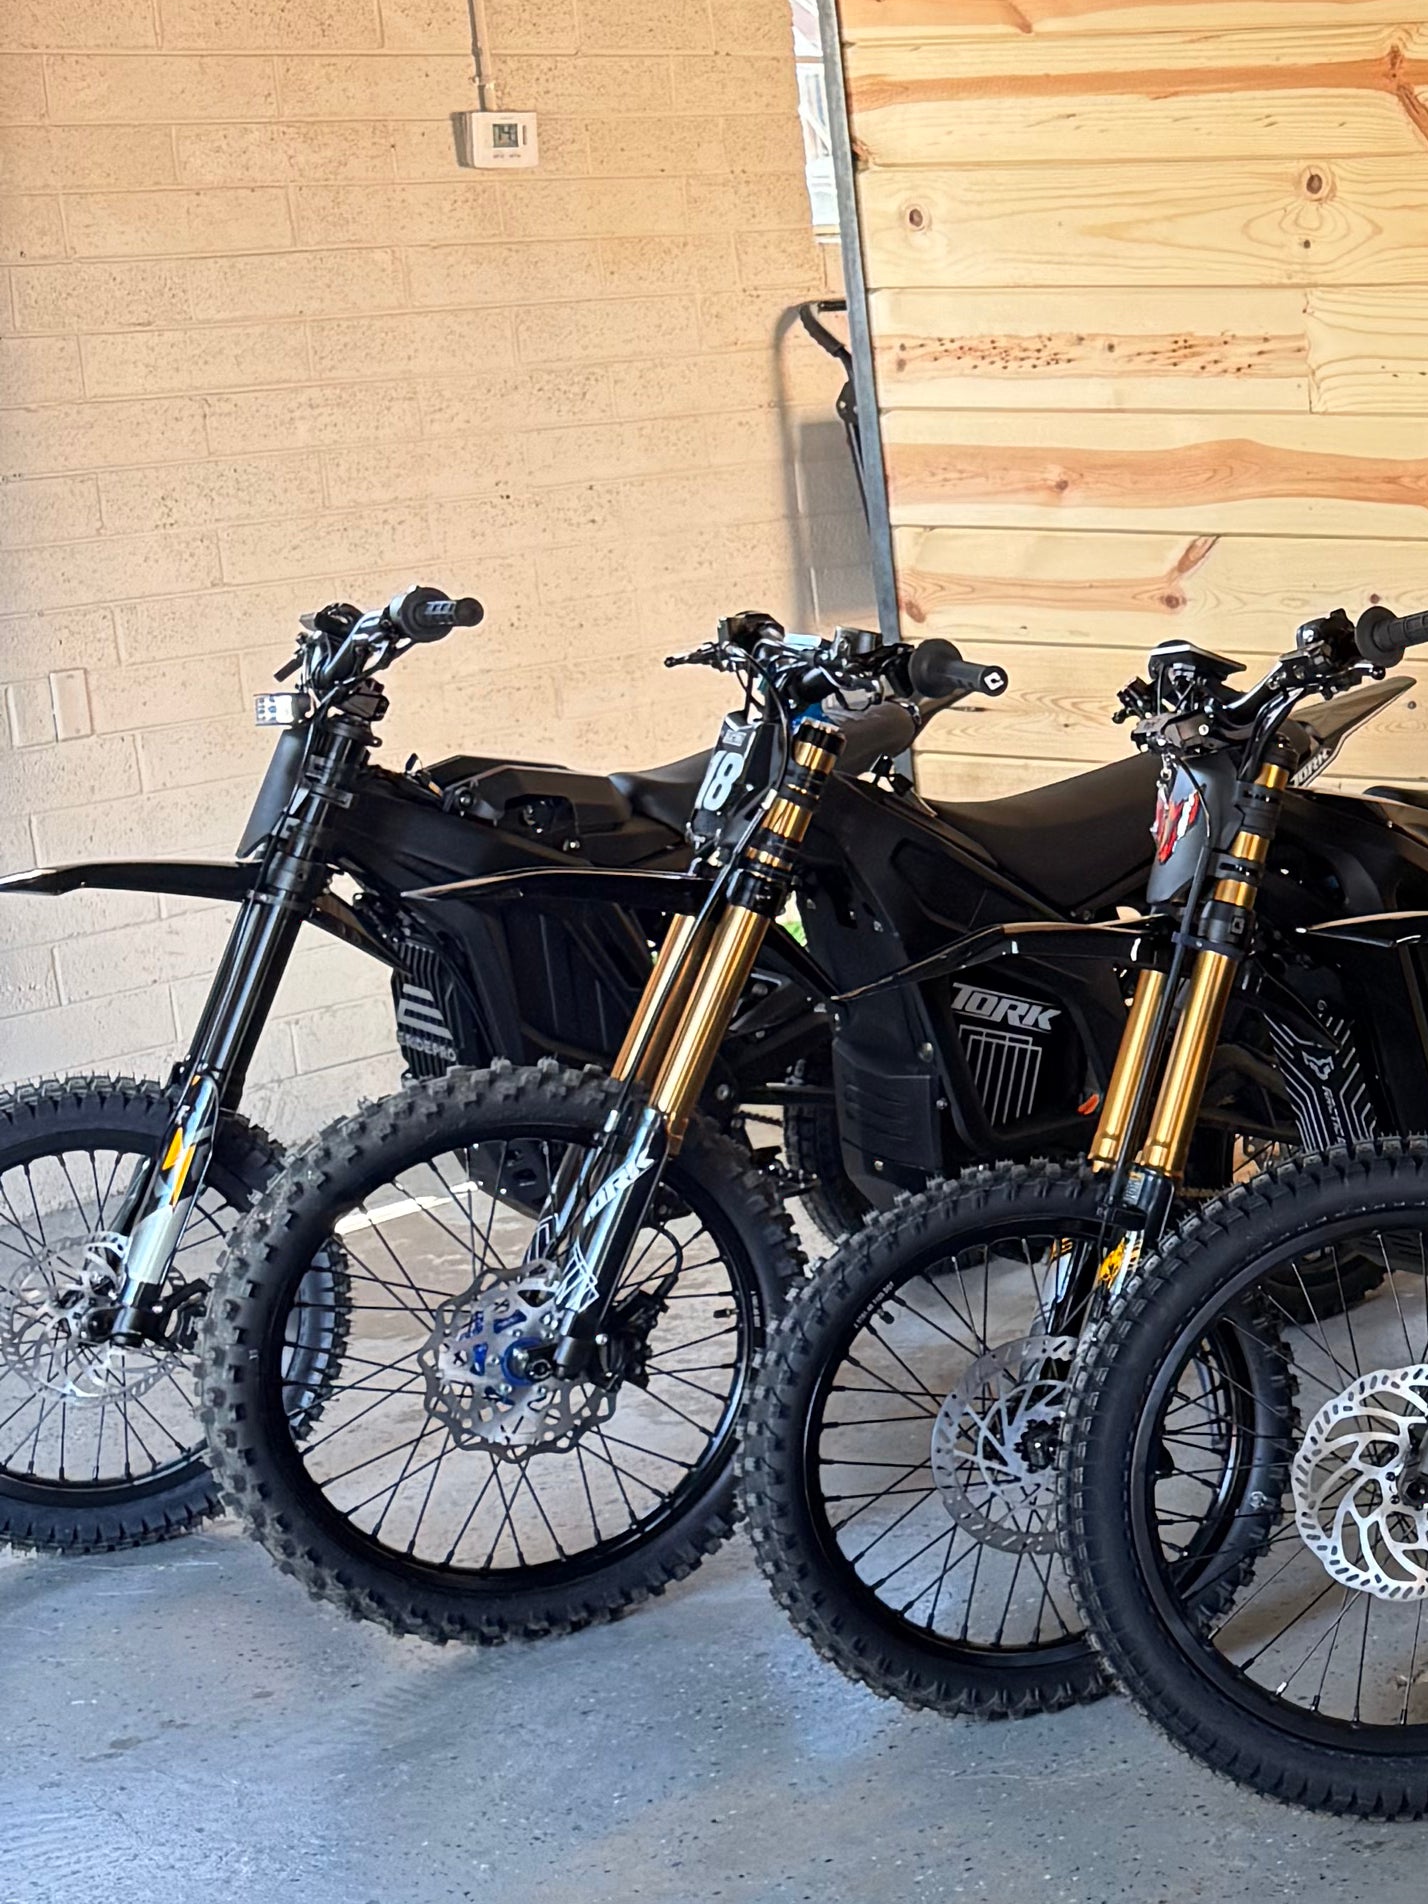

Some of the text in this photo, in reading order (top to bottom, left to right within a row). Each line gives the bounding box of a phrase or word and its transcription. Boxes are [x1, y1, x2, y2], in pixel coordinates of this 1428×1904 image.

[694, 750, 745, 811] 18
[1289, 748, 1332, 788] TORK
[951, 982, 1062, 1034] TORK
